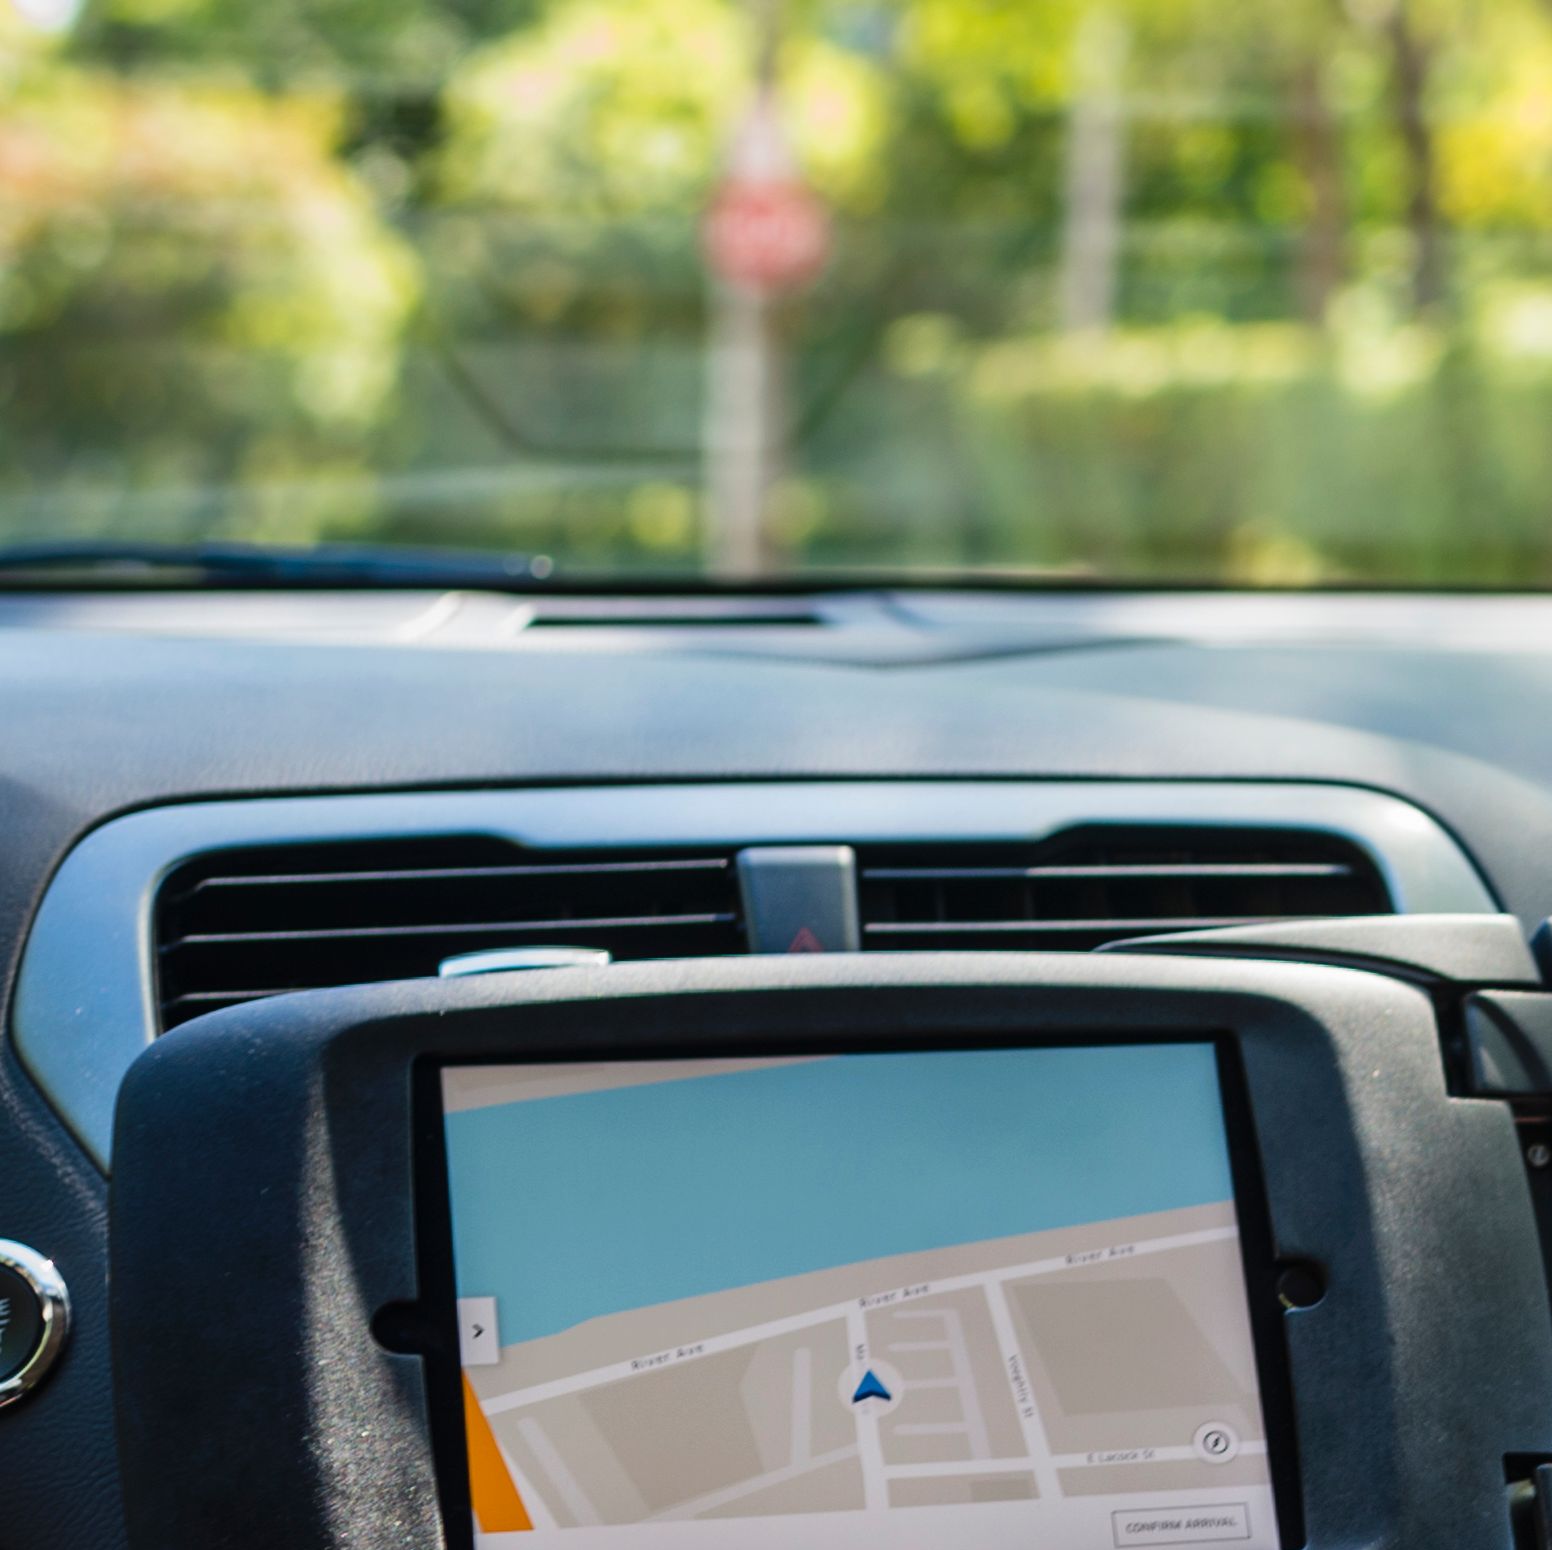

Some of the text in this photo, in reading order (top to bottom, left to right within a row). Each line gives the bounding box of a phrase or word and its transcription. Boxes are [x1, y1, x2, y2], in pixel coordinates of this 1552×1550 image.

[1065, 1245, 1135, 1265] River Ave
[859, 1284, 929, 1308] River Ave
[631, 1344, 704, 1371] River Ave
[1142, 1449, 1155, 1460] St
[1125, 1516, 1238, 1534] CONFIRM ARRIVAL
